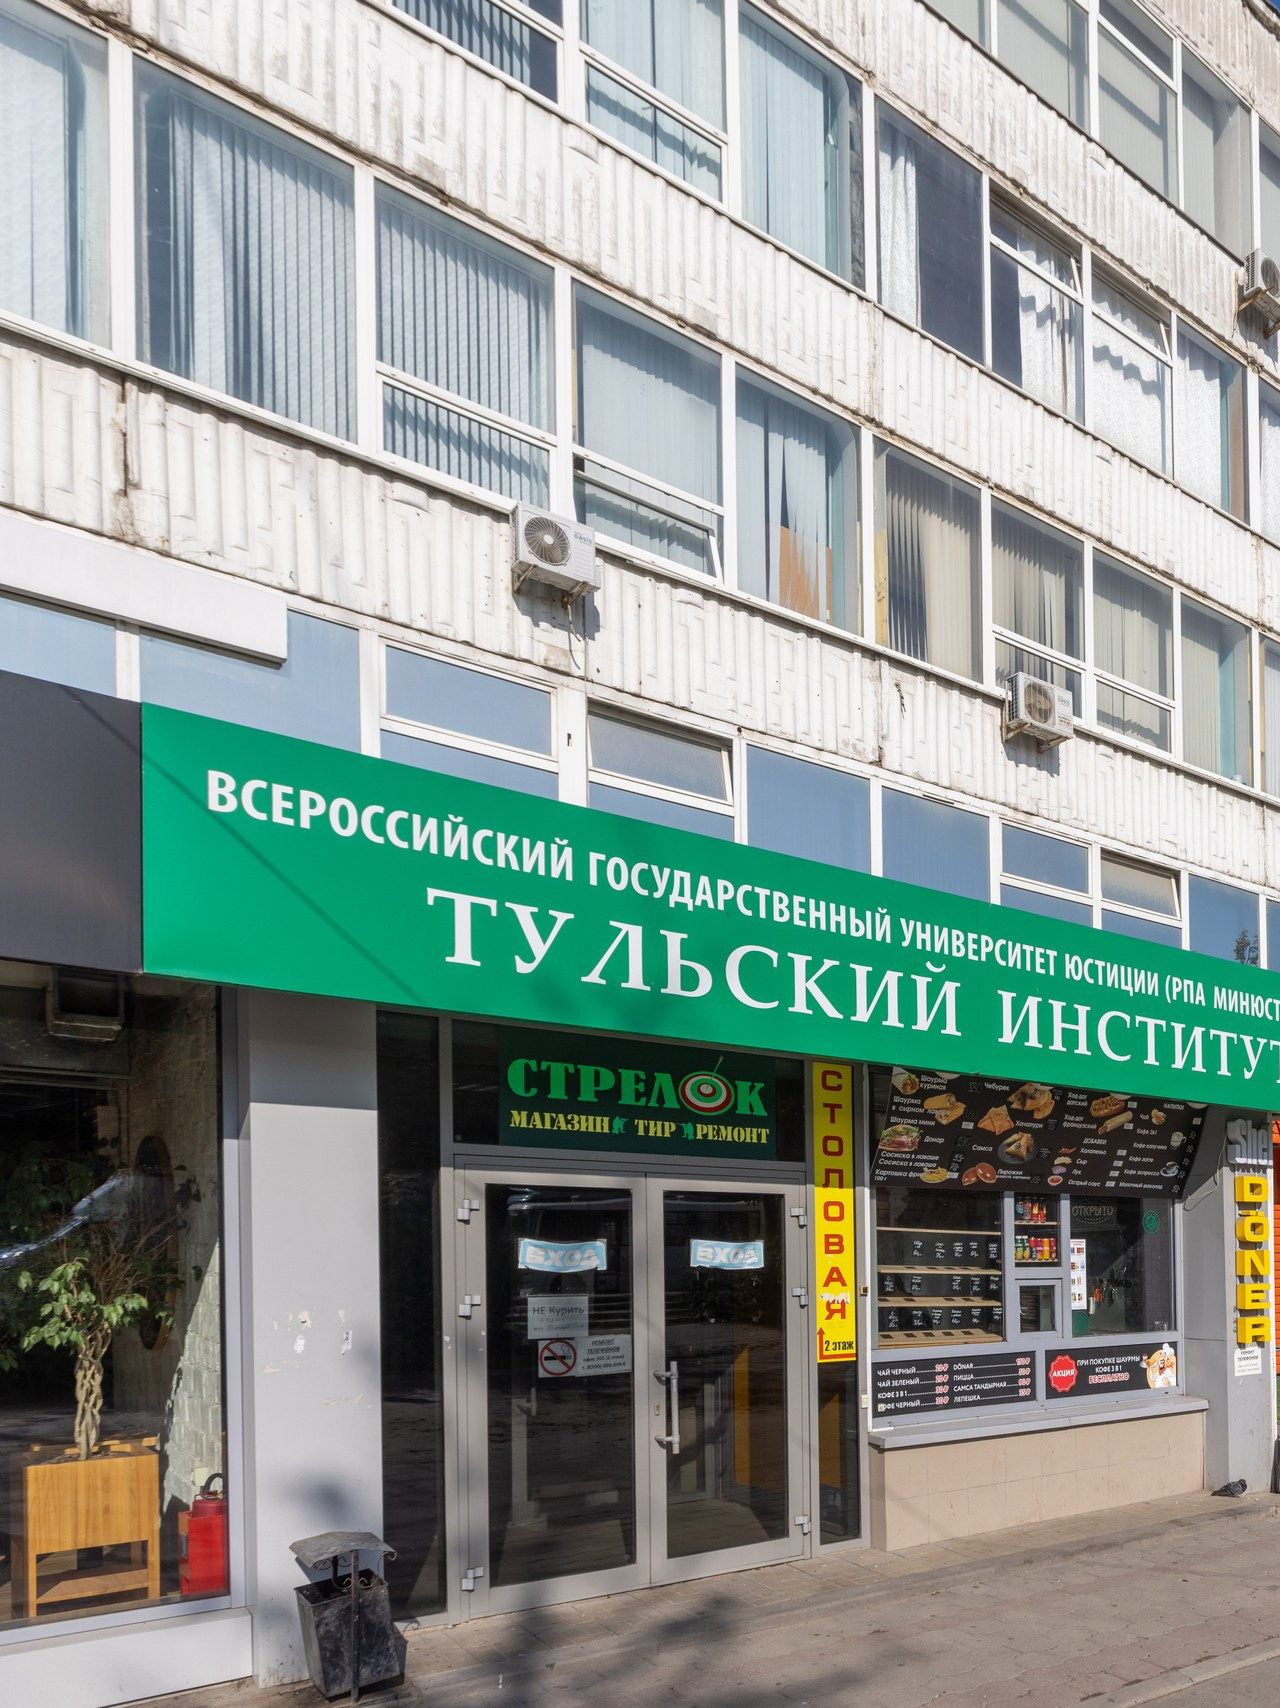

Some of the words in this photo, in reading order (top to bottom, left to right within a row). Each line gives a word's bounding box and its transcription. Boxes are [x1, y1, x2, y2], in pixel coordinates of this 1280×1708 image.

[206, 769, 574, 882] ВСЕРОССИЙСКИЙ
[588, 850, 892, 945] ГОСУДАРСТВЕННЫЙ
[901, 919, 1059, 977] УНИВЕРСИТЕТ
[1065, 954, 1159, 998] ЮСТИЦИИ
[1165, 973, 1206, 1007] (РПА
[427, 887, 962, 1037] ТУЛЬСКИЙ
[921, 1074, 948, 1085] Шаурма
[507, 1057, 768, 1116] СТРЕЛОК
[920, 1083, 947, 1092] куриная
[984, 1082, 1010, 1092] Чебурек
[893, 1096, 922, 1106] Шаурма
[899, 1106, 925, 1114] сырном
[890, 1116, 918, 1126] Шаурма
[1016, 1120, 1044, 1129] Хачапури
[510, 1109, 610, 1135] МАГАЗИН
[634, 1118, 677, 1138] ТИР
[696, 1123, 769, 1144] РЕМОНТ
[1063, 1122, 1098, 1130] французский
[924, 1135, 945, 1144] Донар
[1083, 1137, 1108, 1145] ДОБАВКИ
[881, 1151, 911, 1160] Сосиска
[879, 1159, 909, 1167] Сосиска
[875, 1169, 908, 1178] Картошка
[998, 1169, 1023, 1178] Пирожки
[1068, 1179, 1087, 1187] Острый
[821, 1070, 848, 1320] СТОЛОВАЯ
[1071, 1205, 1115, 1217] ОТКРЫТО
[526, 1245, 600, 1268] ВХОД
[697, 1245, 759, 1265] ВХОД
[533, 1306, 546, 1315] НЕ
[549, 1306, 585, 1317] Курить
[825, 1340, 830, 1351] 2
[832, 1341, 854, 1351] этаж
[1090, 1357, 1116, 1366] ПОКУПКЕ
[1116, 1355, 1141, 1364] ШАУРМЫ
[891, 1367, 916, 1375] ЧЕРНЫЙ
[1052, 1369, 1075, 1378] АКЦИЯ
[891, 1378, 920, 1387] ЗЕЛЕНЫЙ
[953, 1374, 974, 1382] ПИЦЦА
[1089, 1373, 1130, 1385] БЕСПЛАТНО
[974, 1382, 1007, 1391] ТАНДЫРНАЯ
[953, 1395, 981, 1403] ЛЕПЕШКА
[895, 1400, 921, 1409] ЧЕРНЫЙ
